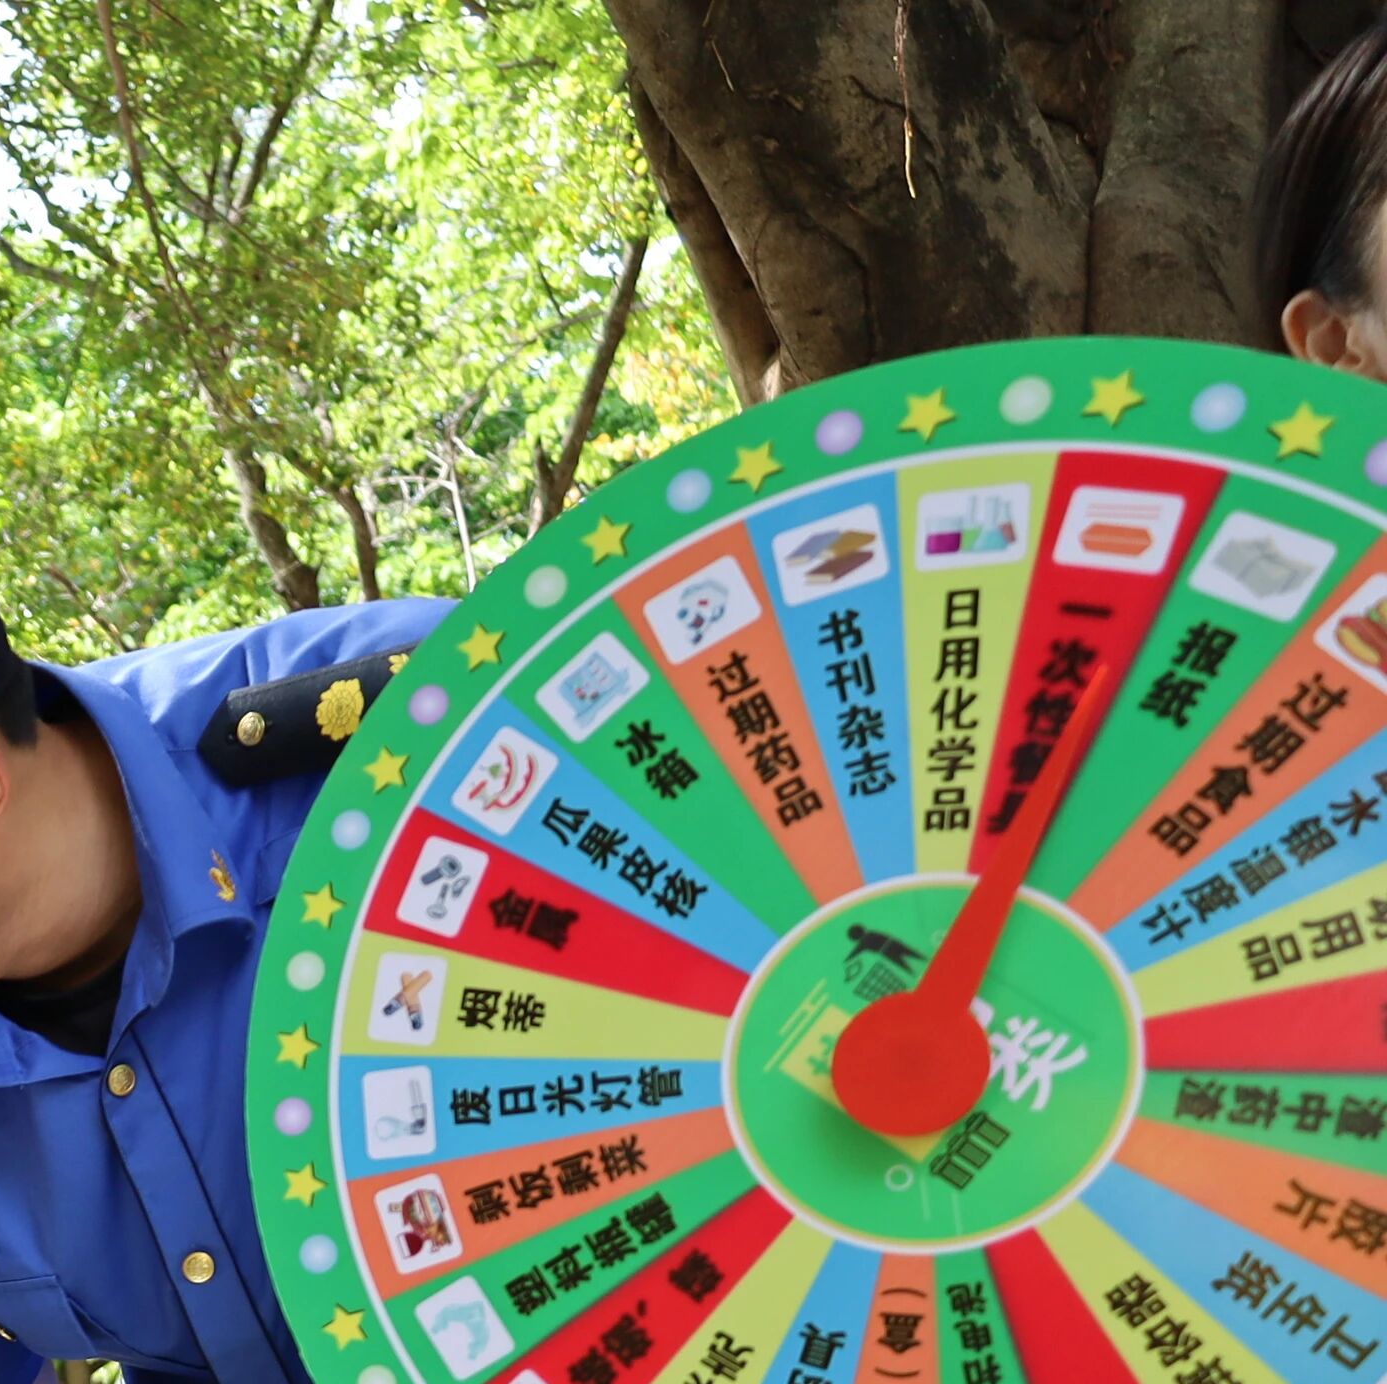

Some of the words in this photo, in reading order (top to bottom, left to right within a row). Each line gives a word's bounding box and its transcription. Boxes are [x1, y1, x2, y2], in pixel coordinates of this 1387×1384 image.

[818, 608, 897, 799] 书刊杂志
[923, 588, 981, 832] 日用化学品
[986, 601, 1113, 835] 一次性
[1138, 620, 1238, 730] 报纸
[614, 718, 699, 802] 冰箱
[707, 650, 824, 829] 过期药品
[1147, 671, 1348, 858] 过期食品
[540, 796, 709, 920] 瓜果皮核
[1140, 769, 1387, 946] 水银温度计
[487, 887, 580, 953] 金属
[457, 986, 547, 1033] 烟蒂
[449, 1064, 684, 1127] 废日光灯管
[463, 1133, 649, 1226] 剩饭剩菜
[504, 1191, 679, 1317] 塑料瓶罐
[1210, 1248, 1380, 1372] 卫生纸
